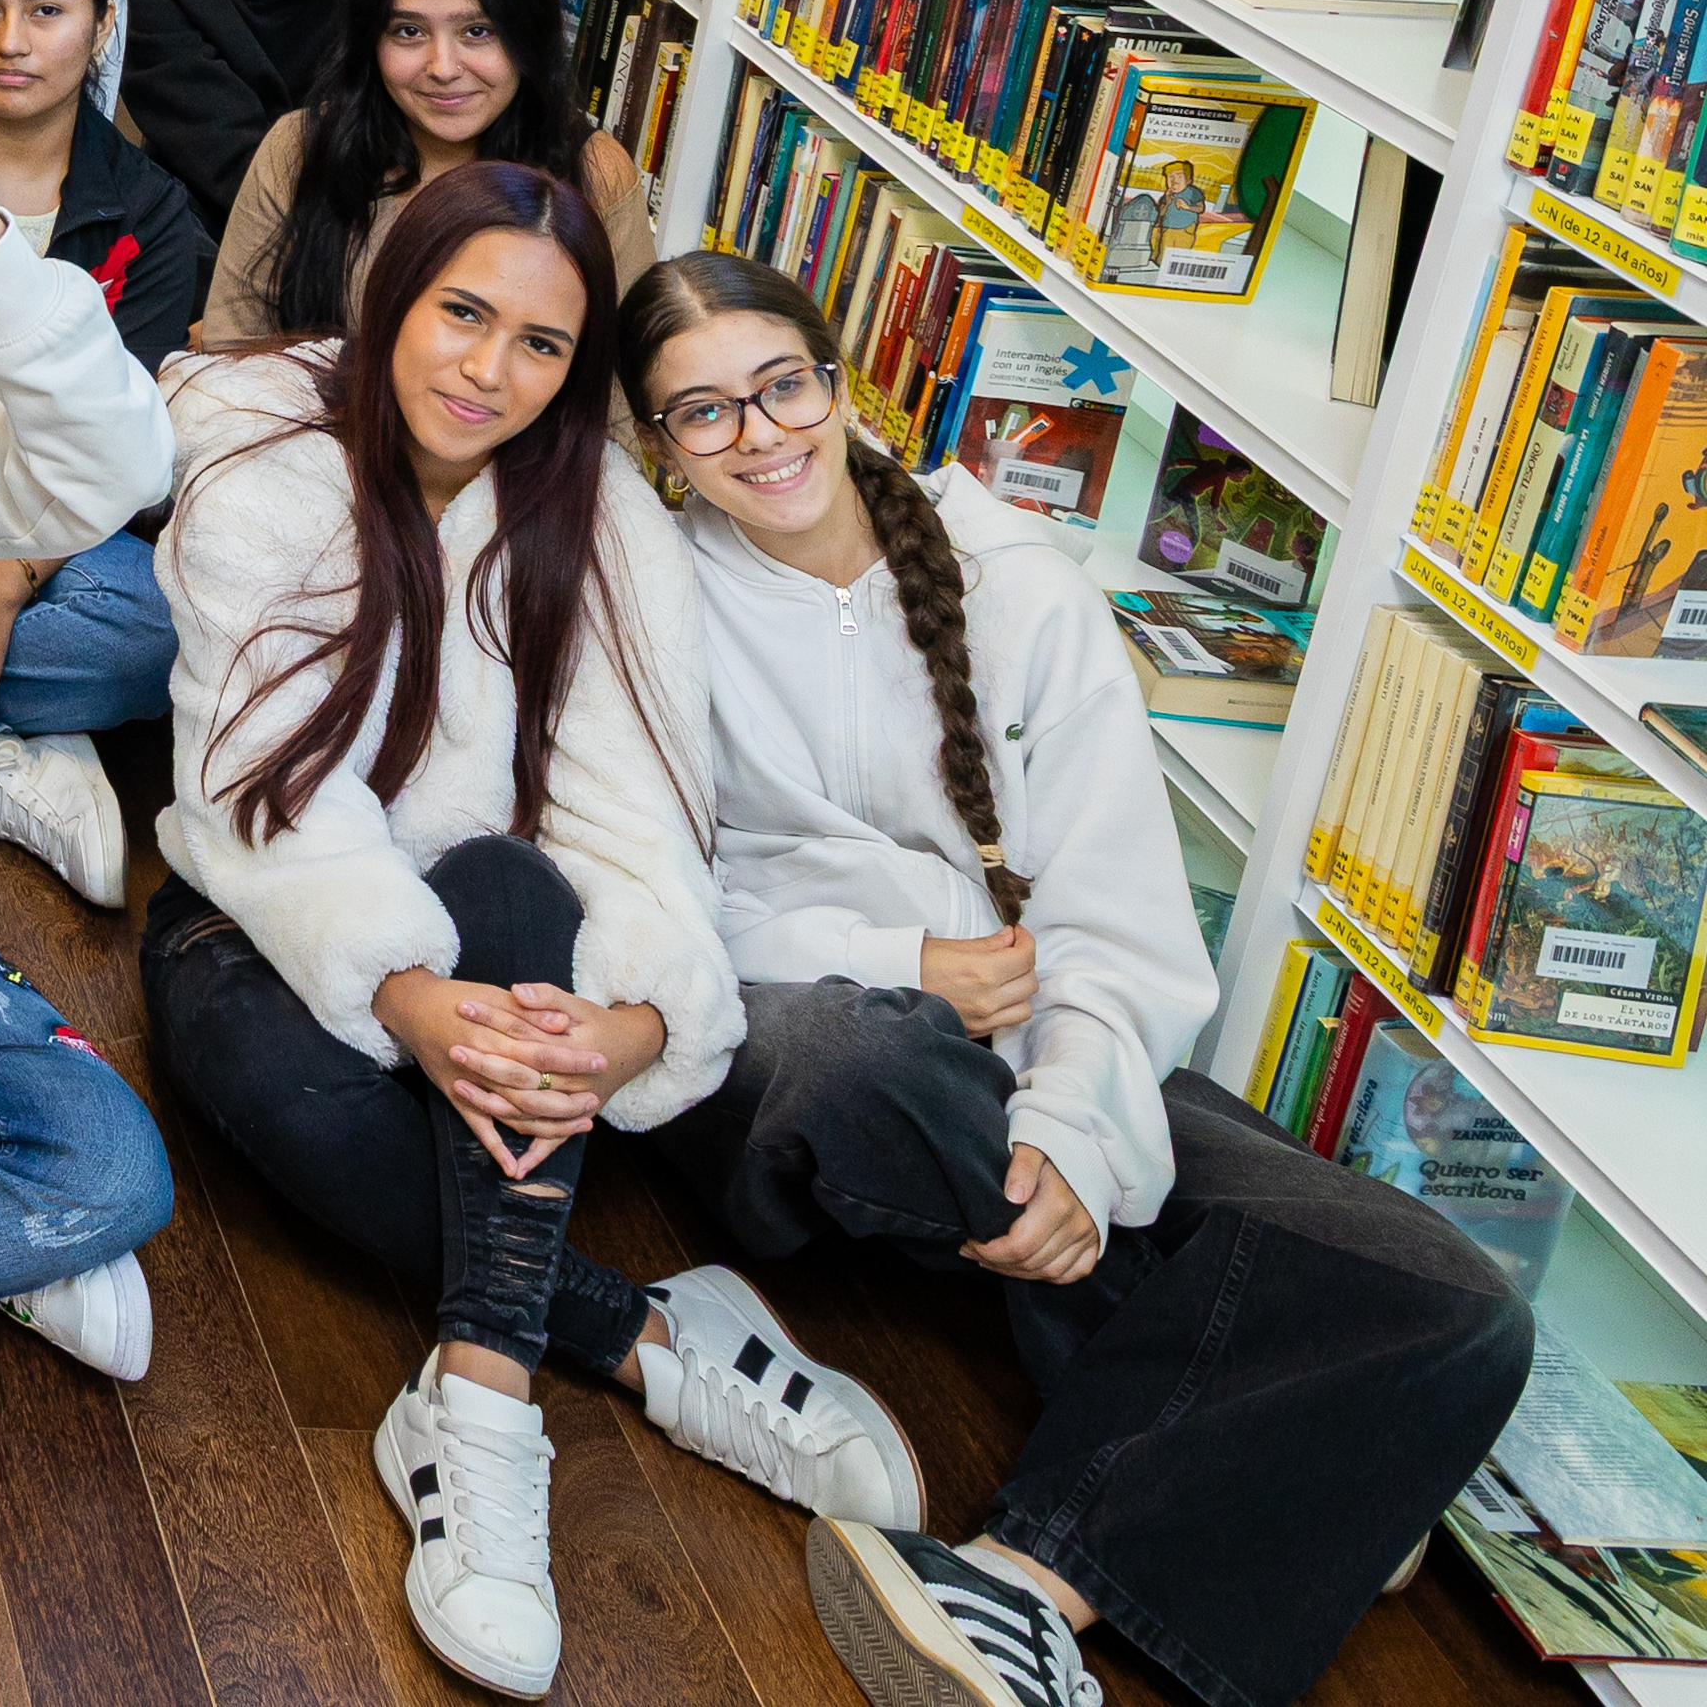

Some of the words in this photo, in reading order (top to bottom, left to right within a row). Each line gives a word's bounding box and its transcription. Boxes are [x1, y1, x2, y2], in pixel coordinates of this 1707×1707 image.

[1151, 104, 1195, 117] DOMENICA
[1148, 116, 1211, 132] VACACIONES
[1146, 127, 1160, 139] EN
[1162, 130, 1175, 141] EL
[1177, 130, 1242, 145] CEMENTERIO
[1537, 202, 1560, 222] J-N
[1559, 213, 1580, 236] (de
[1583, 227, 1601, 246] 12
[1613, 243, 1629, 262] 14
[1630, 257, 1668, 288] años)
[995, 348, 1062, 365] Intercambio
[992, 359, 1014, 373] con
[1016, 362, 1032, 373] un
[1034, 362, 1068, 380] inglés
[1506, 508, 1522, 531] ISLA
[1518, 440, 1547, 492] TESORO
[1410, 562, 1430, 583] J-N
[1431, 573, 1450, 598] (de
[1451, 590, 1467, 610] 12
[1479, 612, 1493, 633] 14
[1493, 625, 1528, 662] años)
[1566, 608, 1585, 626] TWA
[1323, 911, 1343, 936] J-N
[1344, 928, 1362, 955] (de
[1362, 948, 1379, 970] 12
[1389, 970, 1404, 993] 14
[1402, 985, 1434, 1026] años)
[1610, 987, 1644, 1000] CÉSAR
[1645, 992, 1675, 1003] VIDAL
[1563, 1009, 1576, 1020] DE
[1579, 1011, 1599, 1023] LOS
[1601, 1011, 1669, 1032] TÁRTAROS
[1619, 1004, 1633, 1015] EL
[1635, 1005, 1671, 1020] YUGO
[1419, 1159, 1502, 1185] Quiero
[1505, 1165, 1543, 1185] ser
[1419, 1181, 1528, 1203] escritora
